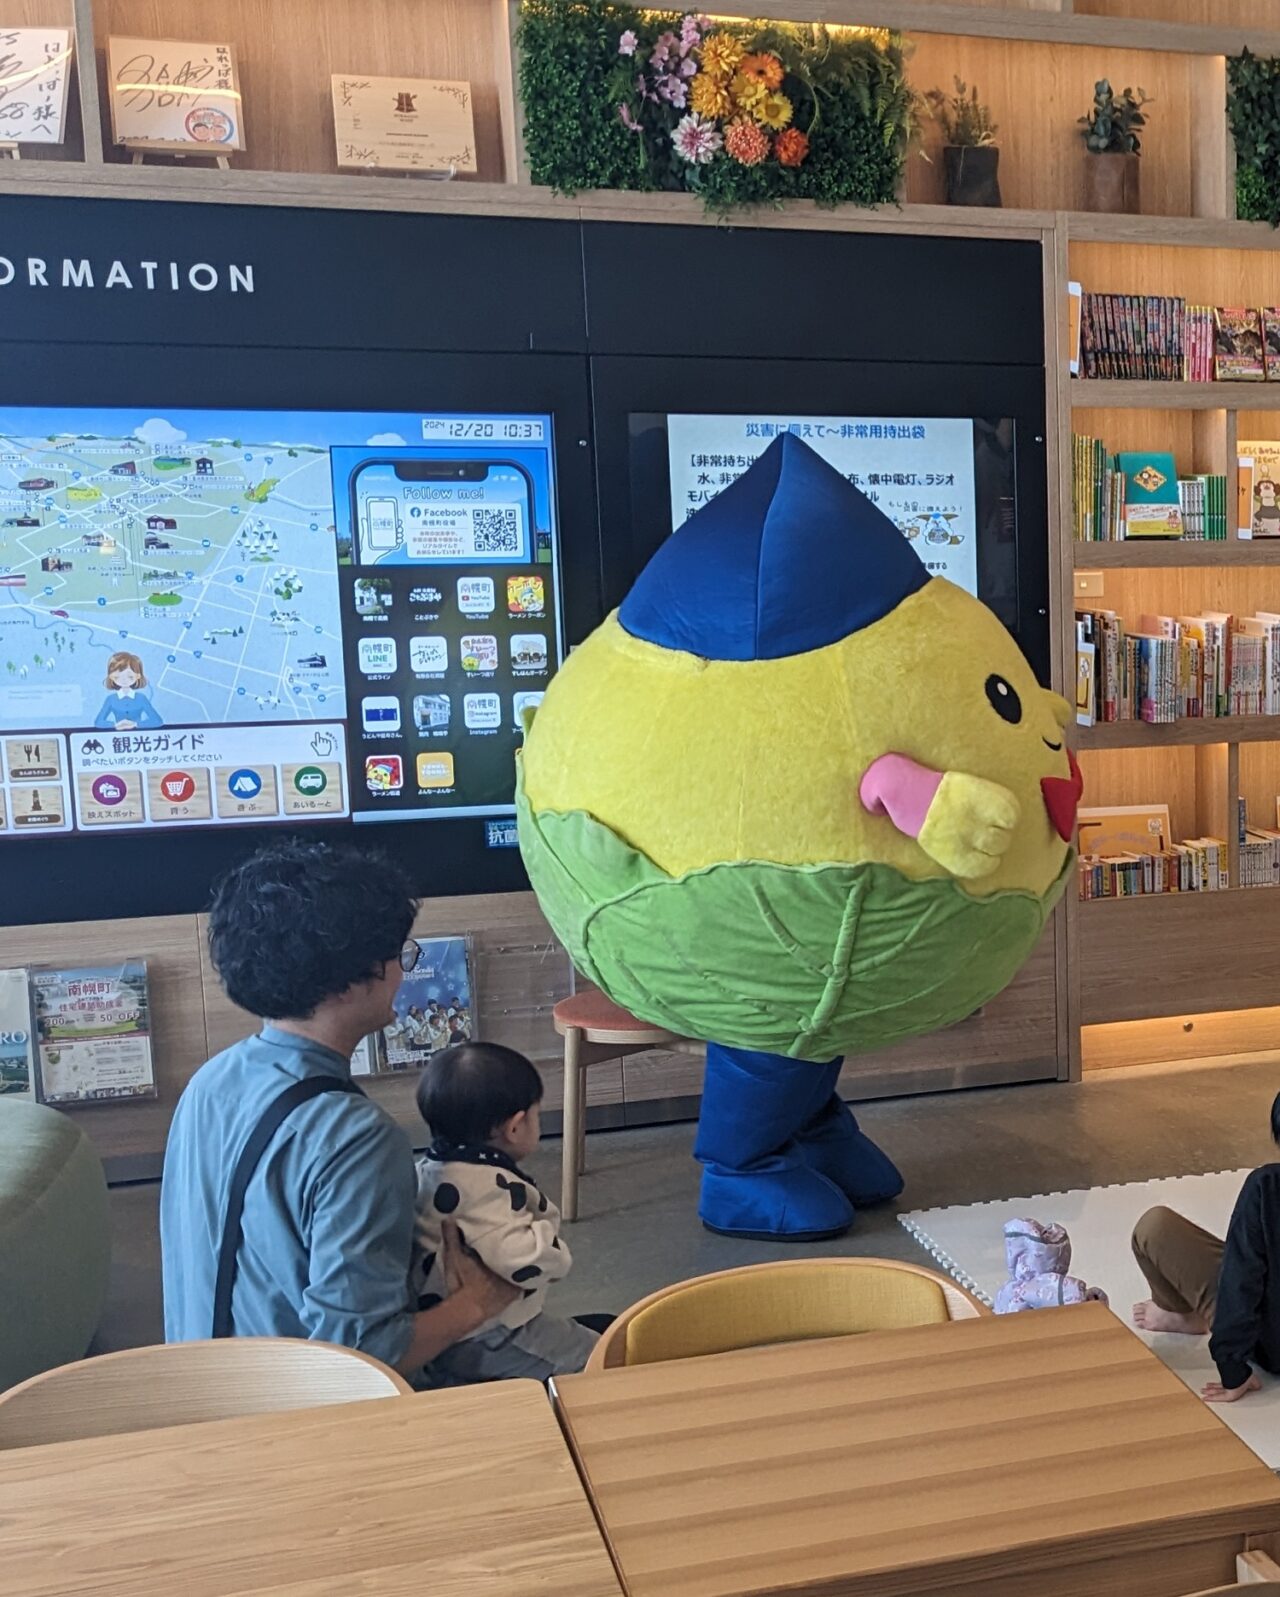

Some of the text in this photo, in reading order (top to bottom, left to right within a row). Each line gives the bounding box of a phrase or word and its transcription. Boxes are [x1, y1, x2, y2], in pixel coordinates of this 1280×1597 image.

[424, 421, 542, 438] 2024 12/20 10:37
[841, 473, 955, 486] 布、懐中電灯、ラジオ
[403, 487, 484, 499] Follow me!
[424, 508, 467, 517] Facebook
[112, 734, 205, 754] 観光ガイド
[82, 754, 222, 767] 調べたいボタンをタッチしてください
[68, 983, 112, 997] 南幌町
